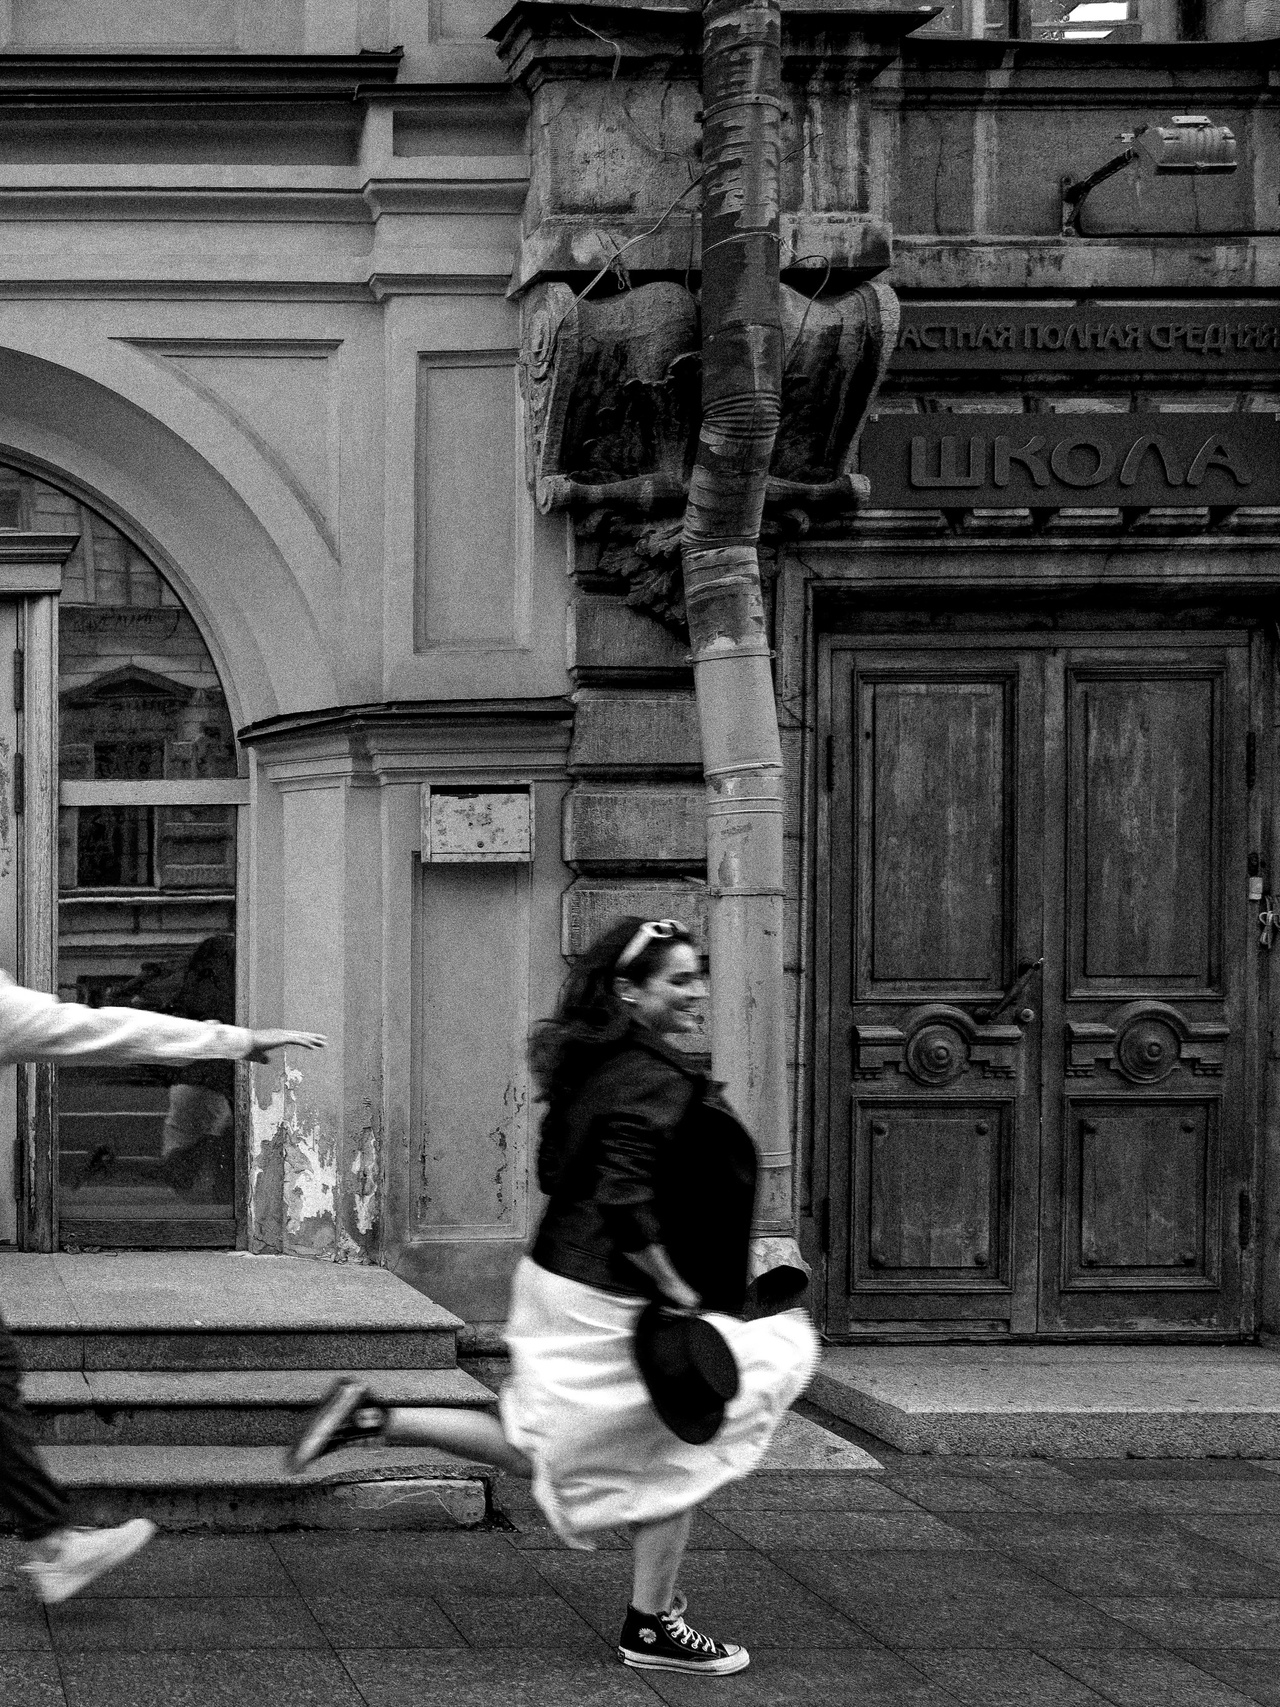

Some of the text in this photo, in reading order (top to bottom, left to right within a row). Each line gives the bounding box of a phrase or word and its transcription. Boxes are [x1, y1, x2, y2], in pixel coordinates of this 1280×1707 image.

[896, 322, 1280, 354] АСТНАЯ ПОЛНАЯ СРЕДНЯЯ
[910, 433, 1253, 487] ШКОЛА
